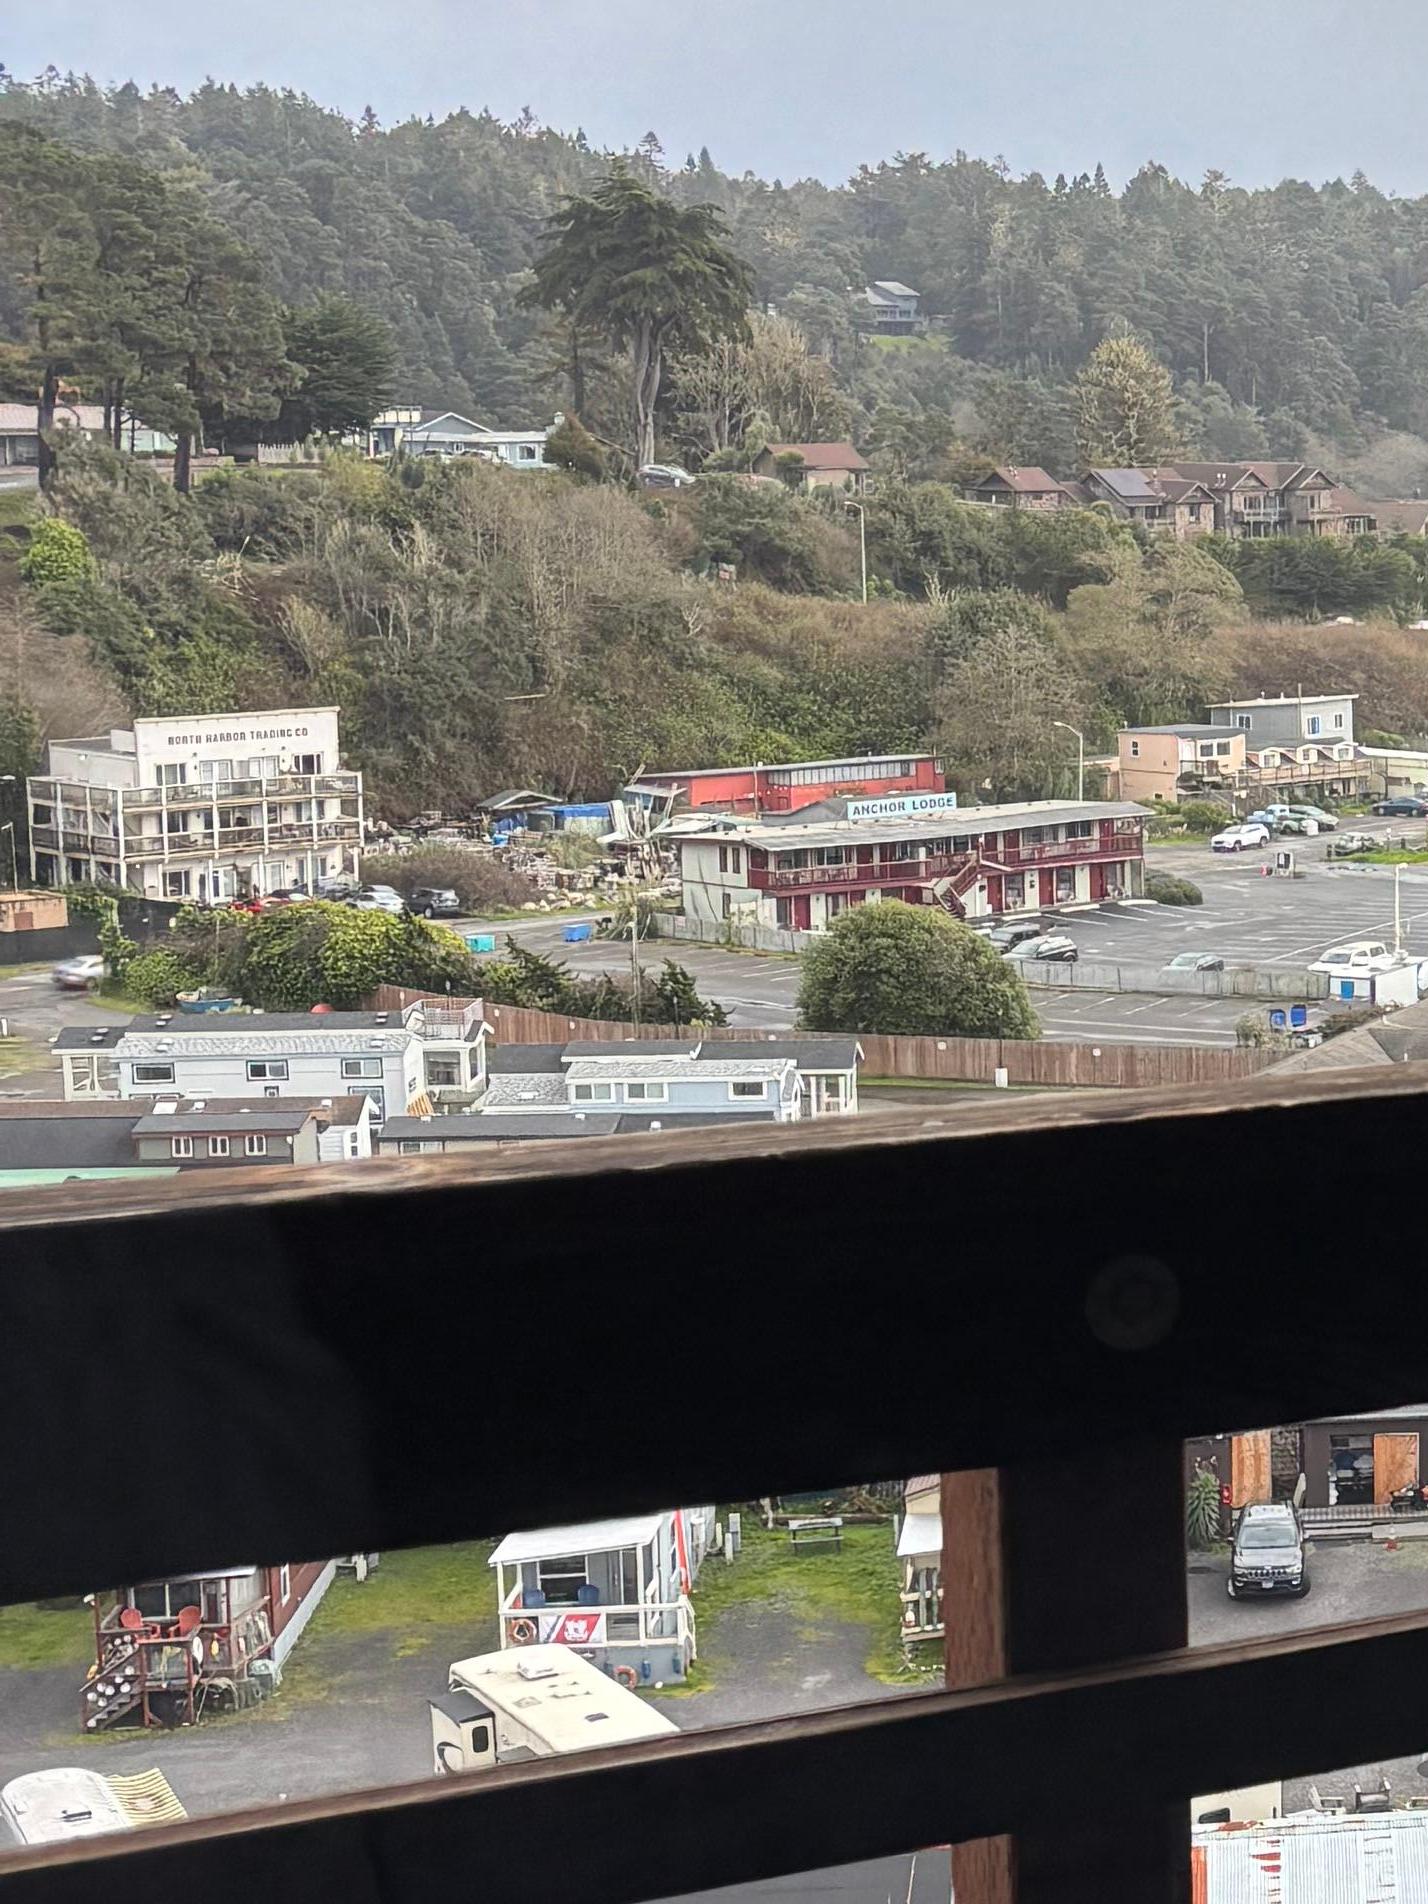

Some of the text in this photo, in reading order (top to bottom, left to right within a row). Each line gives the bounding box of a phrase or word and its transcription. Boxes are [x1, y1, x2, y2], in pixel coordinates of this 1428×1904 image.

[167, 727, 308, 746] NORTH HARBOR TRADING CO
[853, 796, 954, 816] ANCHOR LODGE
